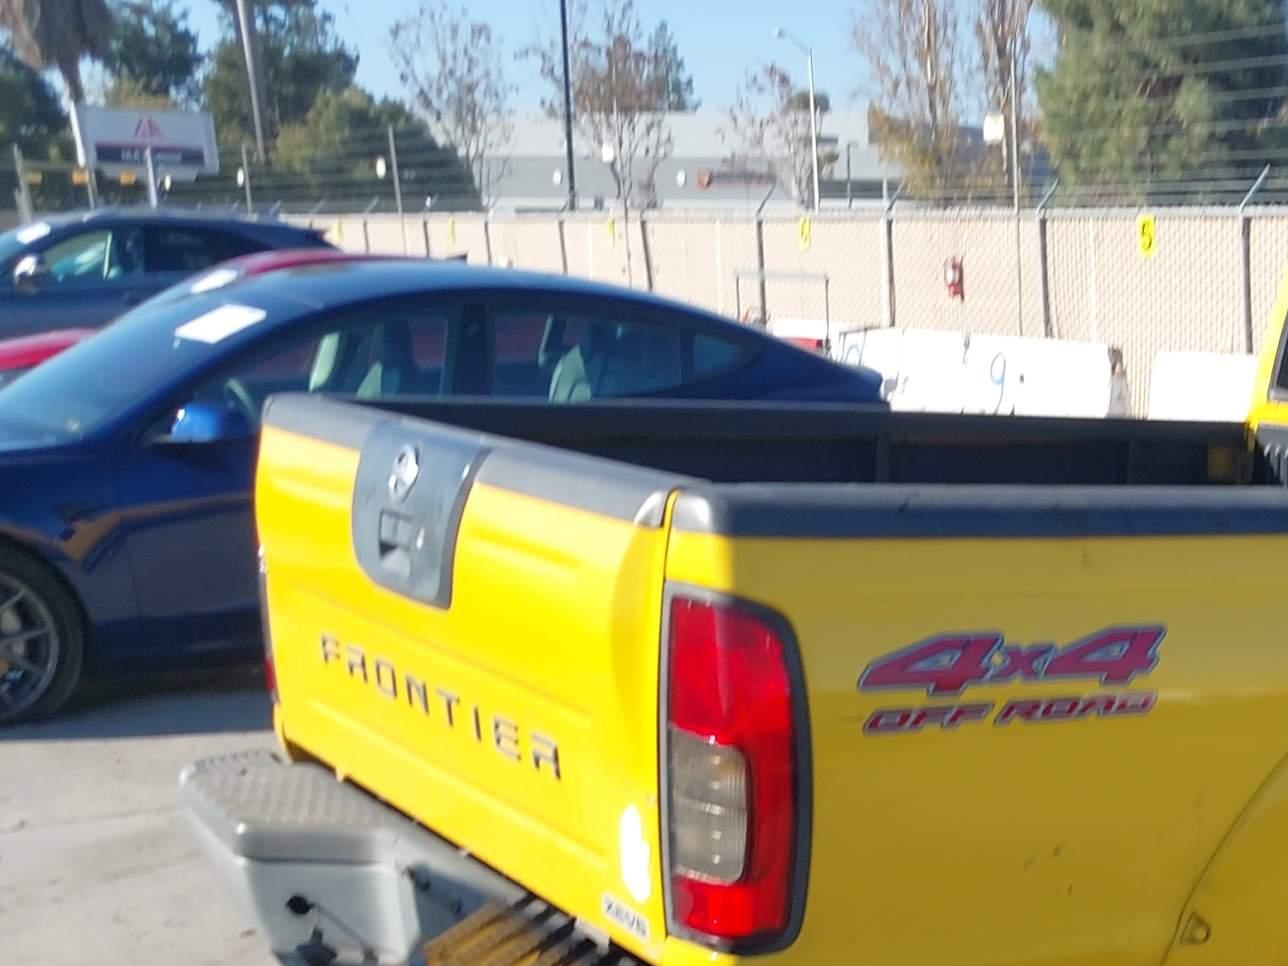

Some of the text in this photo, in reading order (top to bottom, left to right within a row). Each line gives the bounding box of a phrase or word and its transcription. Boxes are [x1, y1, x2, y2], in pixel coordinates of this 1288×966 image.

[857, 622, 1167, 697] 4x4
[321, 632, 562, 781] FRONTIER
[863, 692, 1158, 736] OFF ROAD
